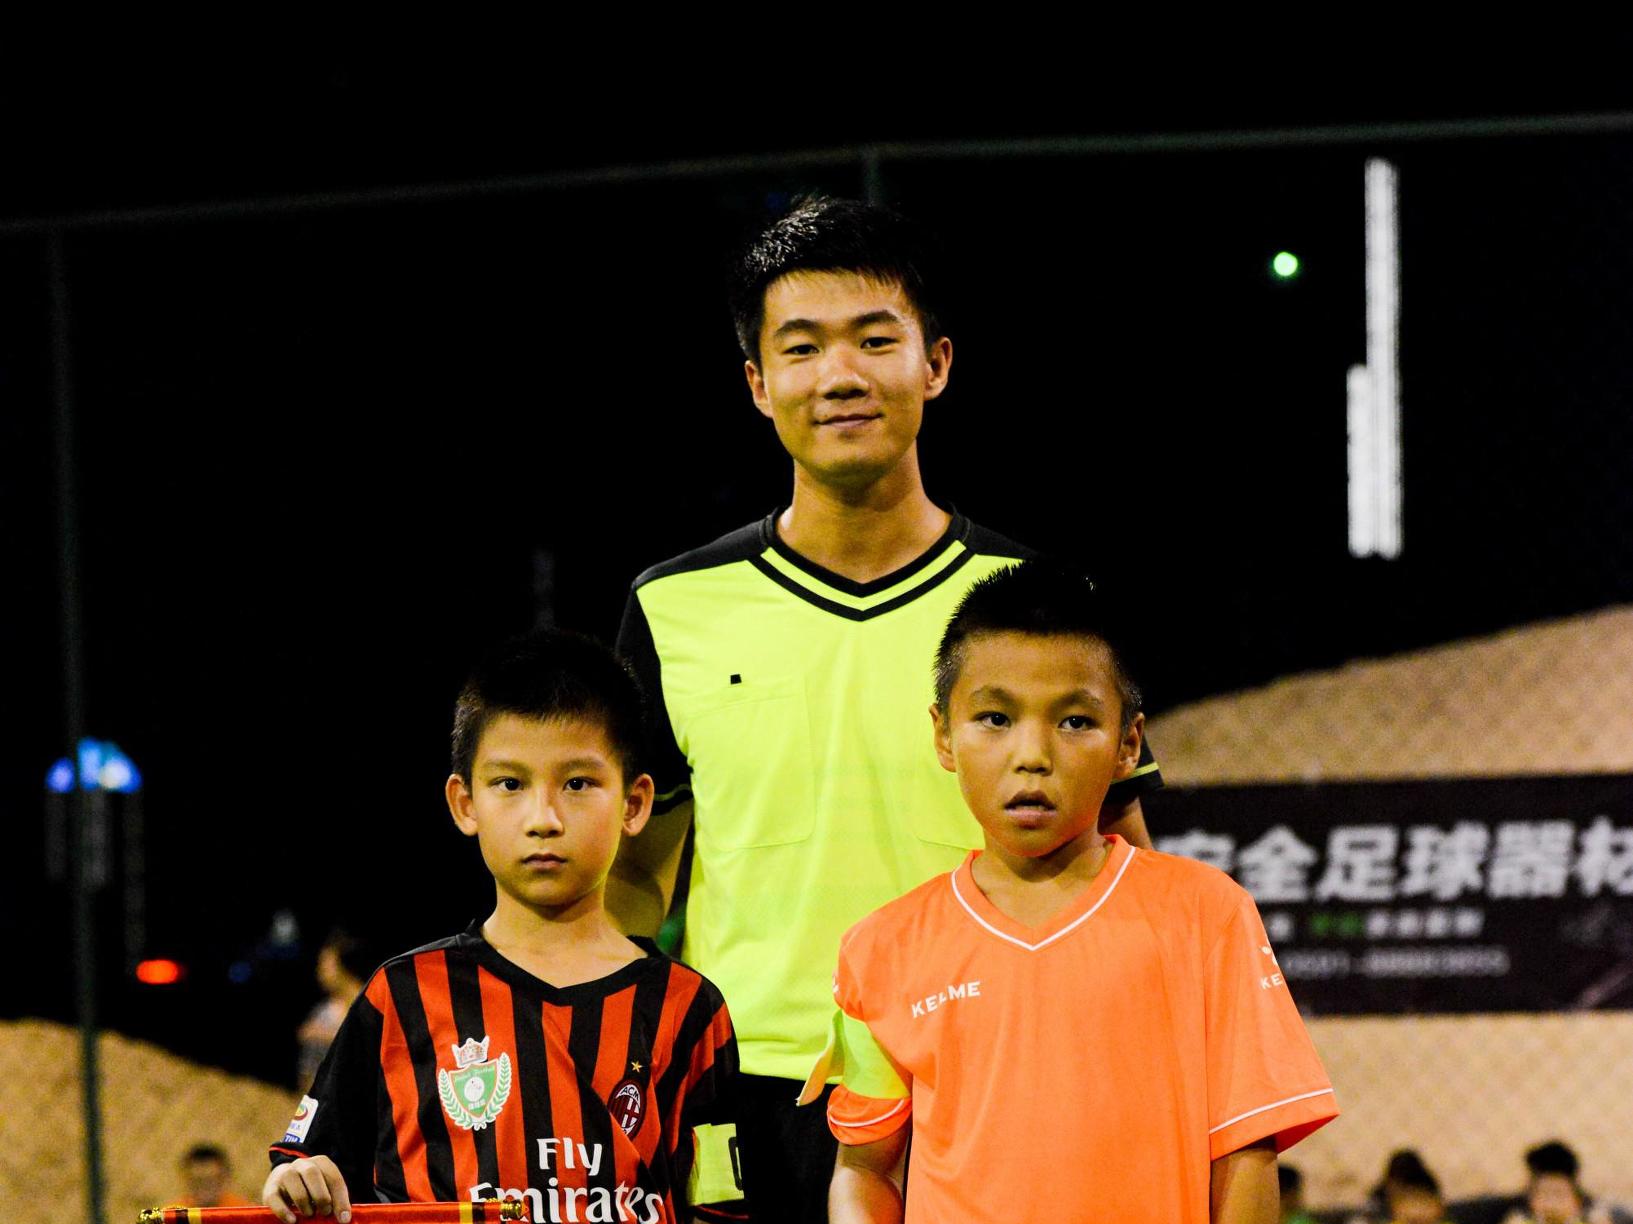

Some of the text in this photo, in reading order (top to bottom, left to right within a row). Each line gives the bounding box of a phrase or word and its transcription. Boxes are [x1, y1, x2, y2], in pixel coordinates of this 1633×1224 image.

[911, 980, 981, 1018] KELME
[619, 1086, 640, 1101] ACM
[536, 1136, 603, 1177] Fly
